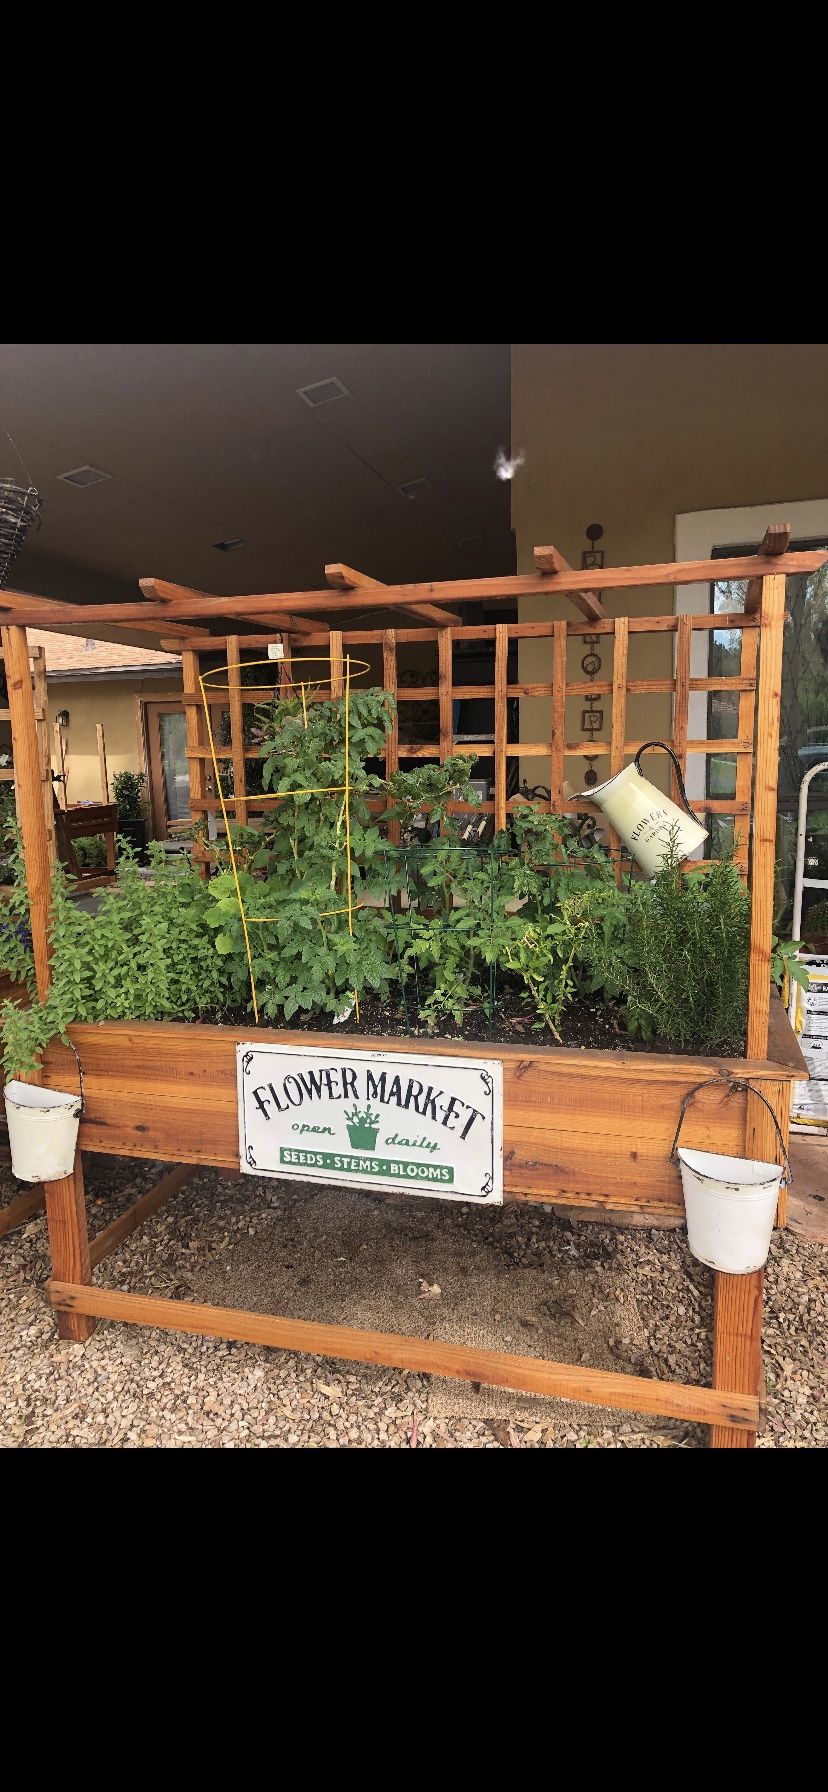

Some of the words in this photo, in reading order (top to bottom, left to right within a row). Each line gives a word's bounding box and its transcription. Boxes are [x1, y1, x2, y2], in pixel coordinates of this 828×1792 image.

[630, 809, 668, 841] FLOWERS
[252, 1066, 360, 1121] FLOWER
[366, 1068, 486, 1142] MARKET
[291, 1121, 336, 1136] open
[385, 1132, 441, 1153] daily
[283, 1149, 324, 1166] SEEDS
[334, 1156, 379, 1172] STEMS
[390, 1163, 450, 1180] BLOOMS
